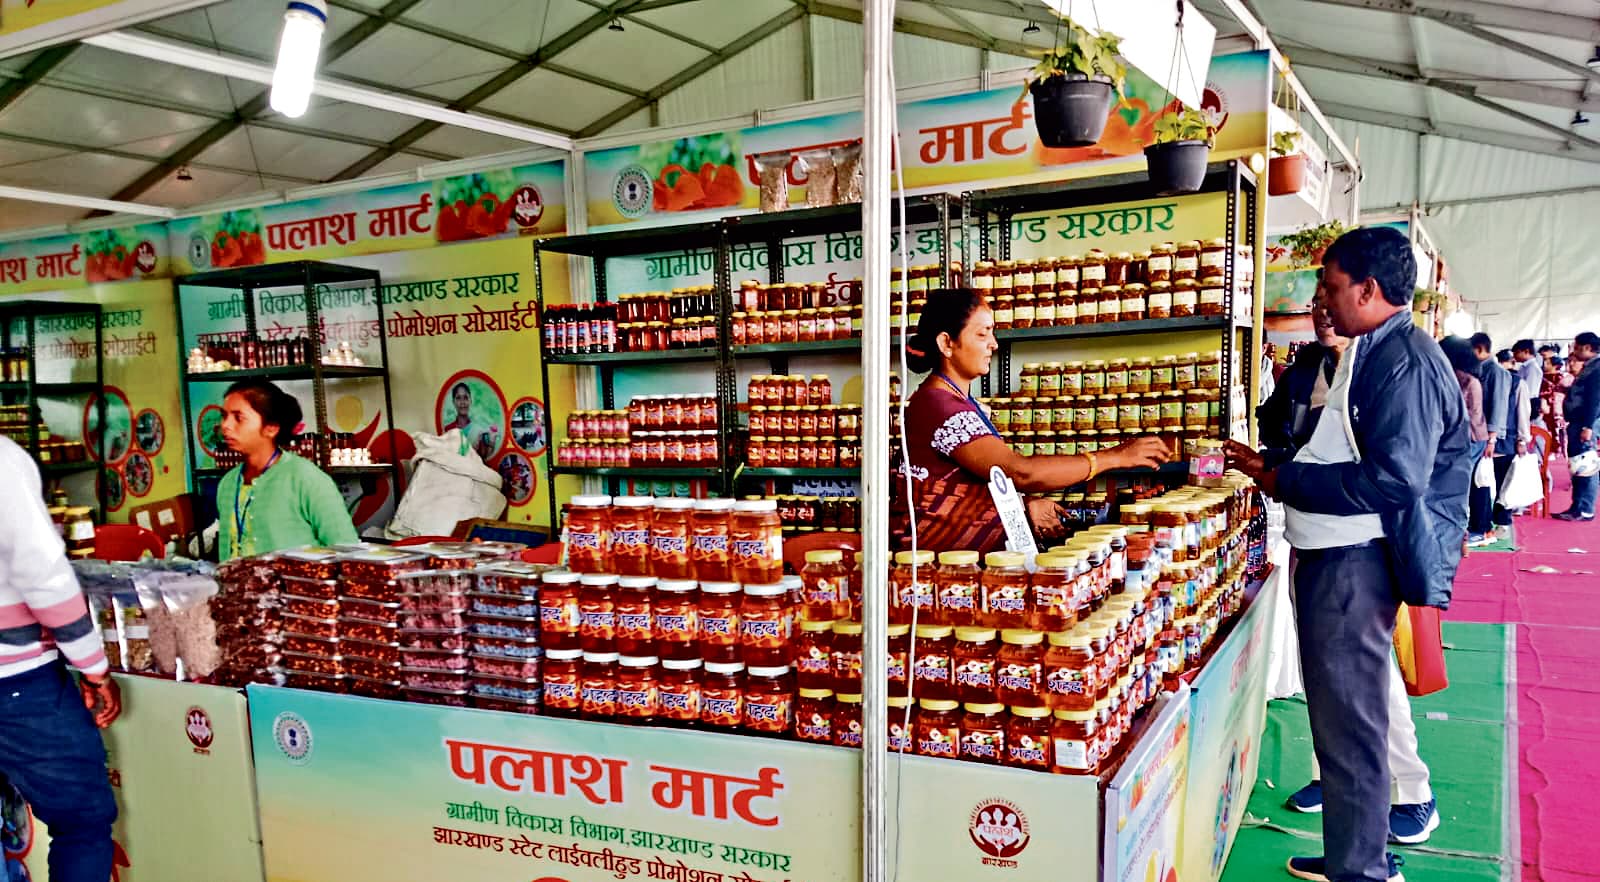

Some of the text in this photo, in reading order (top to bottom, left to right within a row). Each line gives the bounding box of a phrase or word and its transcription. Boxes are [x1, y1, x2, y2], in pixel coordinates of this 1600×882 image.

[919, 102, 1032, 165] मार्ट
[265, 193, 433, 252] पलाश मार्ट
[1057, 204, 1177, 240] सरकार
[35, 244, 81, 279] मार्ट
[207, 292, 247, 320] ग्रामी
[453, 272, 520, 298] सरकार
[386, 309, 459, 338] प्रोमोशन
[462, 300, 540, 333] सोसाईटी
[445, 738, 784, 827] पलाश मार्ट
[433, 826, 504, 853] झारखण्ड
[507, 834, 543, 860] स्टेट
[548, 843, 642, 880] लाईवलीहुड
[646, 856, 724, 882] प्रोमोशन
[445, 801, 499, 825] ग्रामीण
[506, 805, 563, 834] विकास
[720, 844, 792, 872] सरकार
